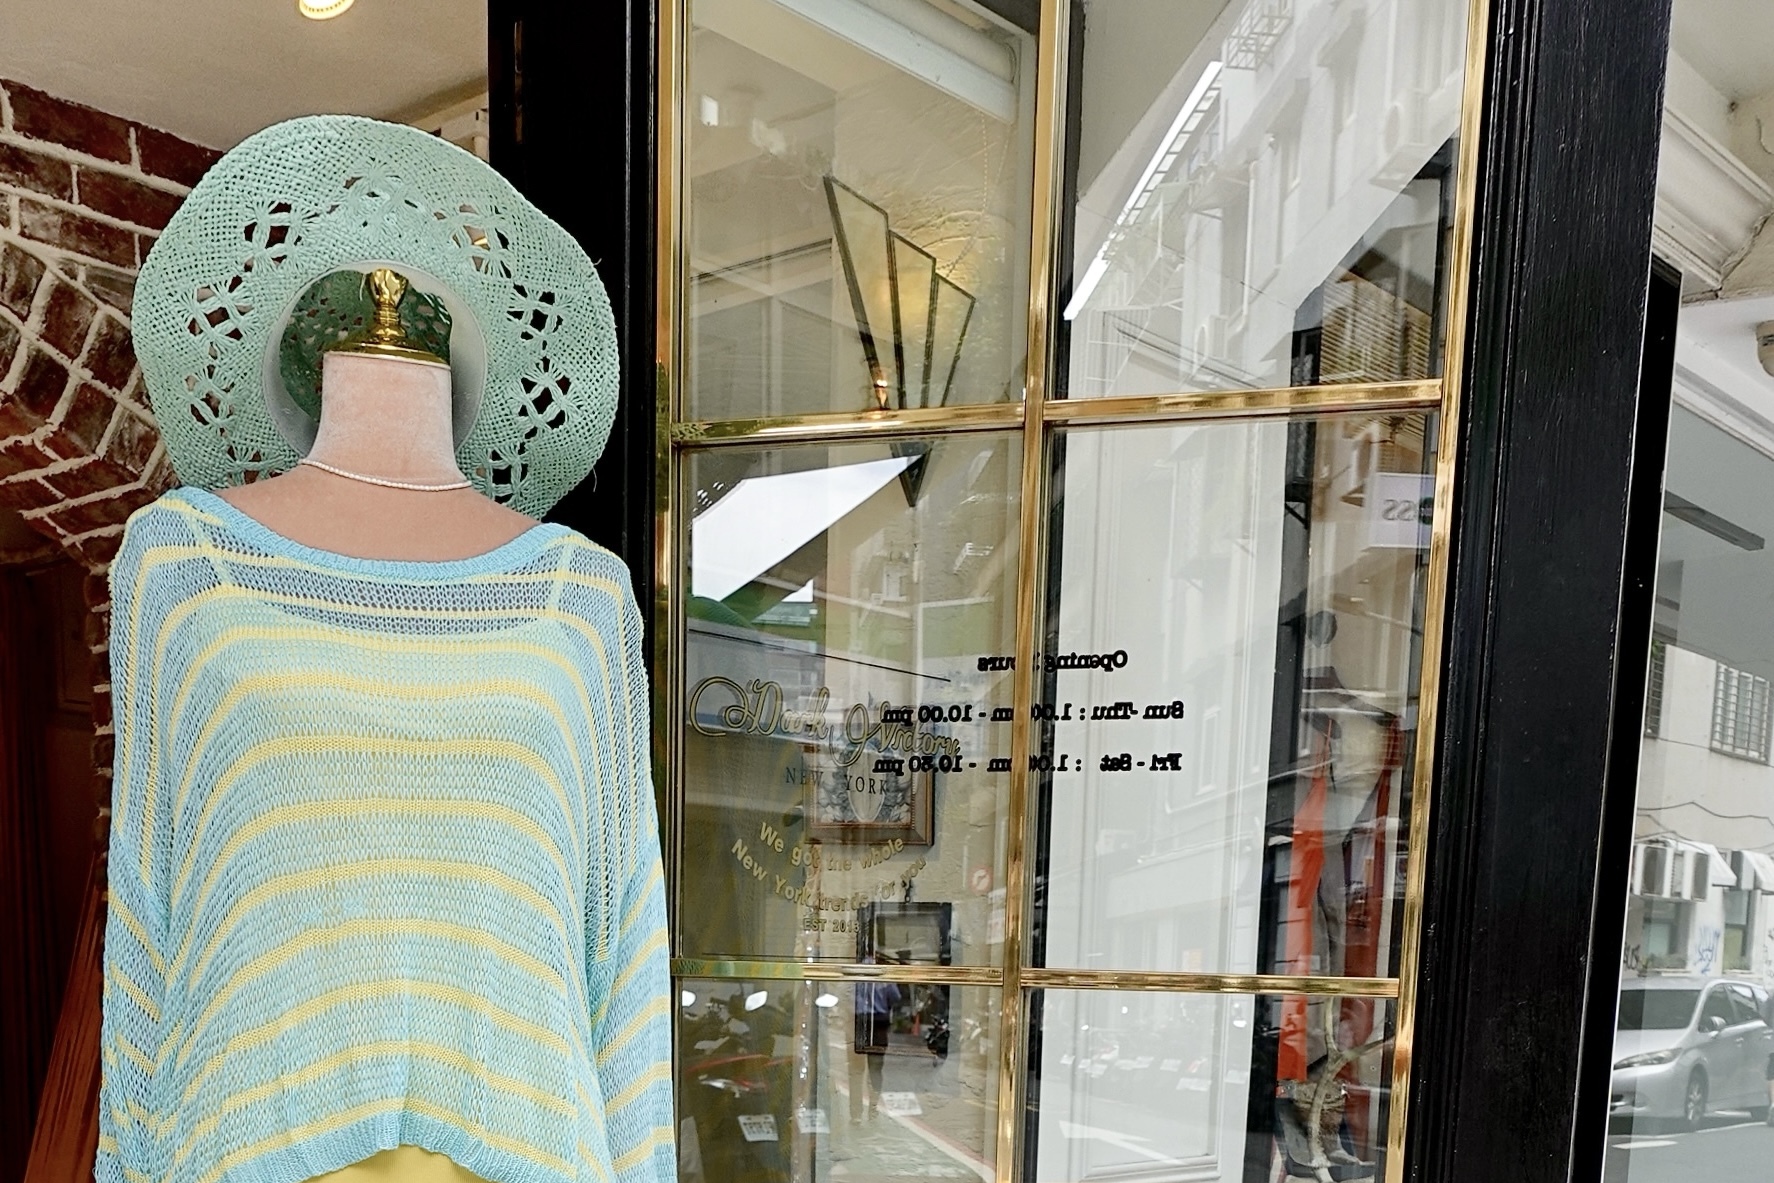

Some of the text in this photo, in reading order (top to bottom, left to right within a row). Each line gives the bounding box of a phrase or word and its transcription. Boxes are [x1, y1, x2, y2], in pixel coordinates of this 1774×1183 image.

[689, 675, 961, 766] Dark Victory
[785, 766, 888, 796] NEW YORK
[760, 821, 785, 853] We
[791, 846, 822, 869] got
[858, 837, 905, 869] whole
[731, 838, 768, 881] New
[774, 874, 815, 908] York
[818, 889, 870, 912] trends
[900, 855, 927, 889] you
[803, 917, 828, 932] EST
